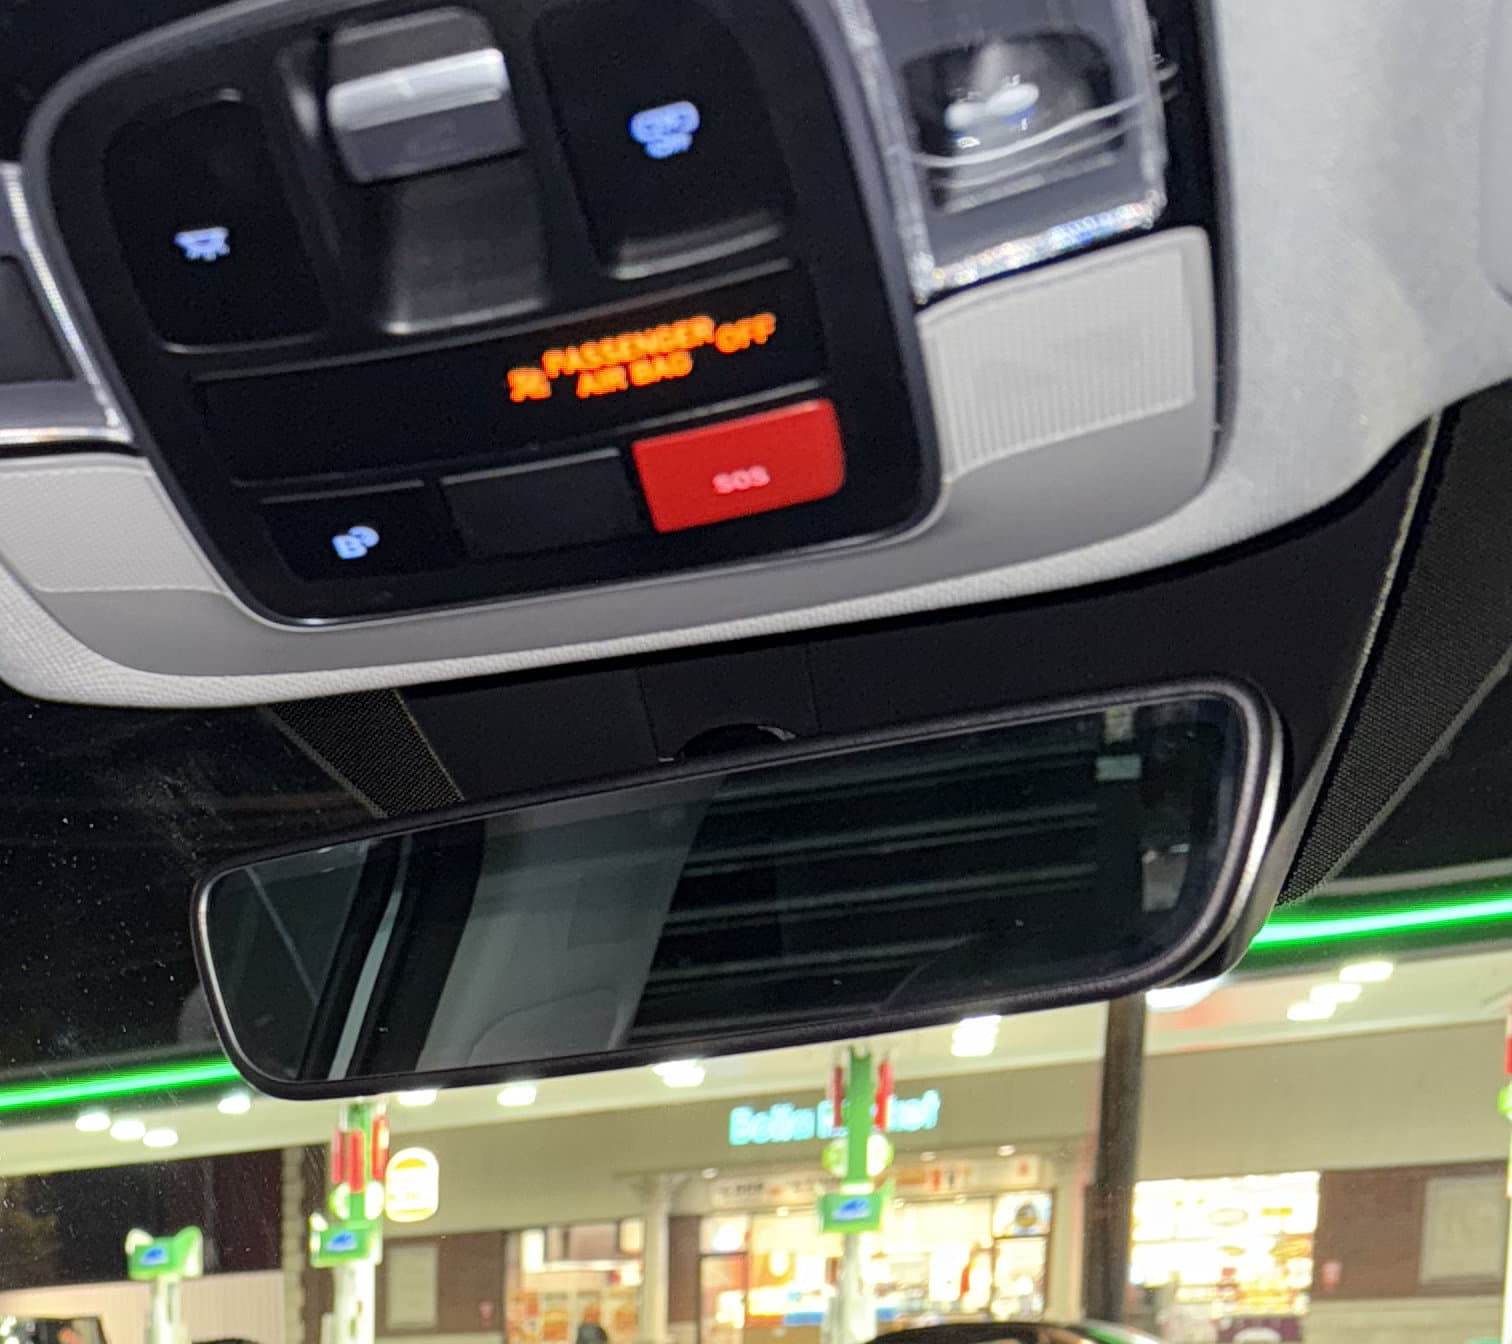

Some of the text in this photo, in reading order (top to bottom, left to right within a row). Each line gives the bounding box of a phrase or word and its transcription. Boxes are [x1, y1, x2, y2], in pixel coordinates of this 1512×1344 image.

[542, 312, 777, 379] PASSENGER OFF
[577, 350, 694, 399] AIR BAG
[712, 464, 771, 494] SOS
